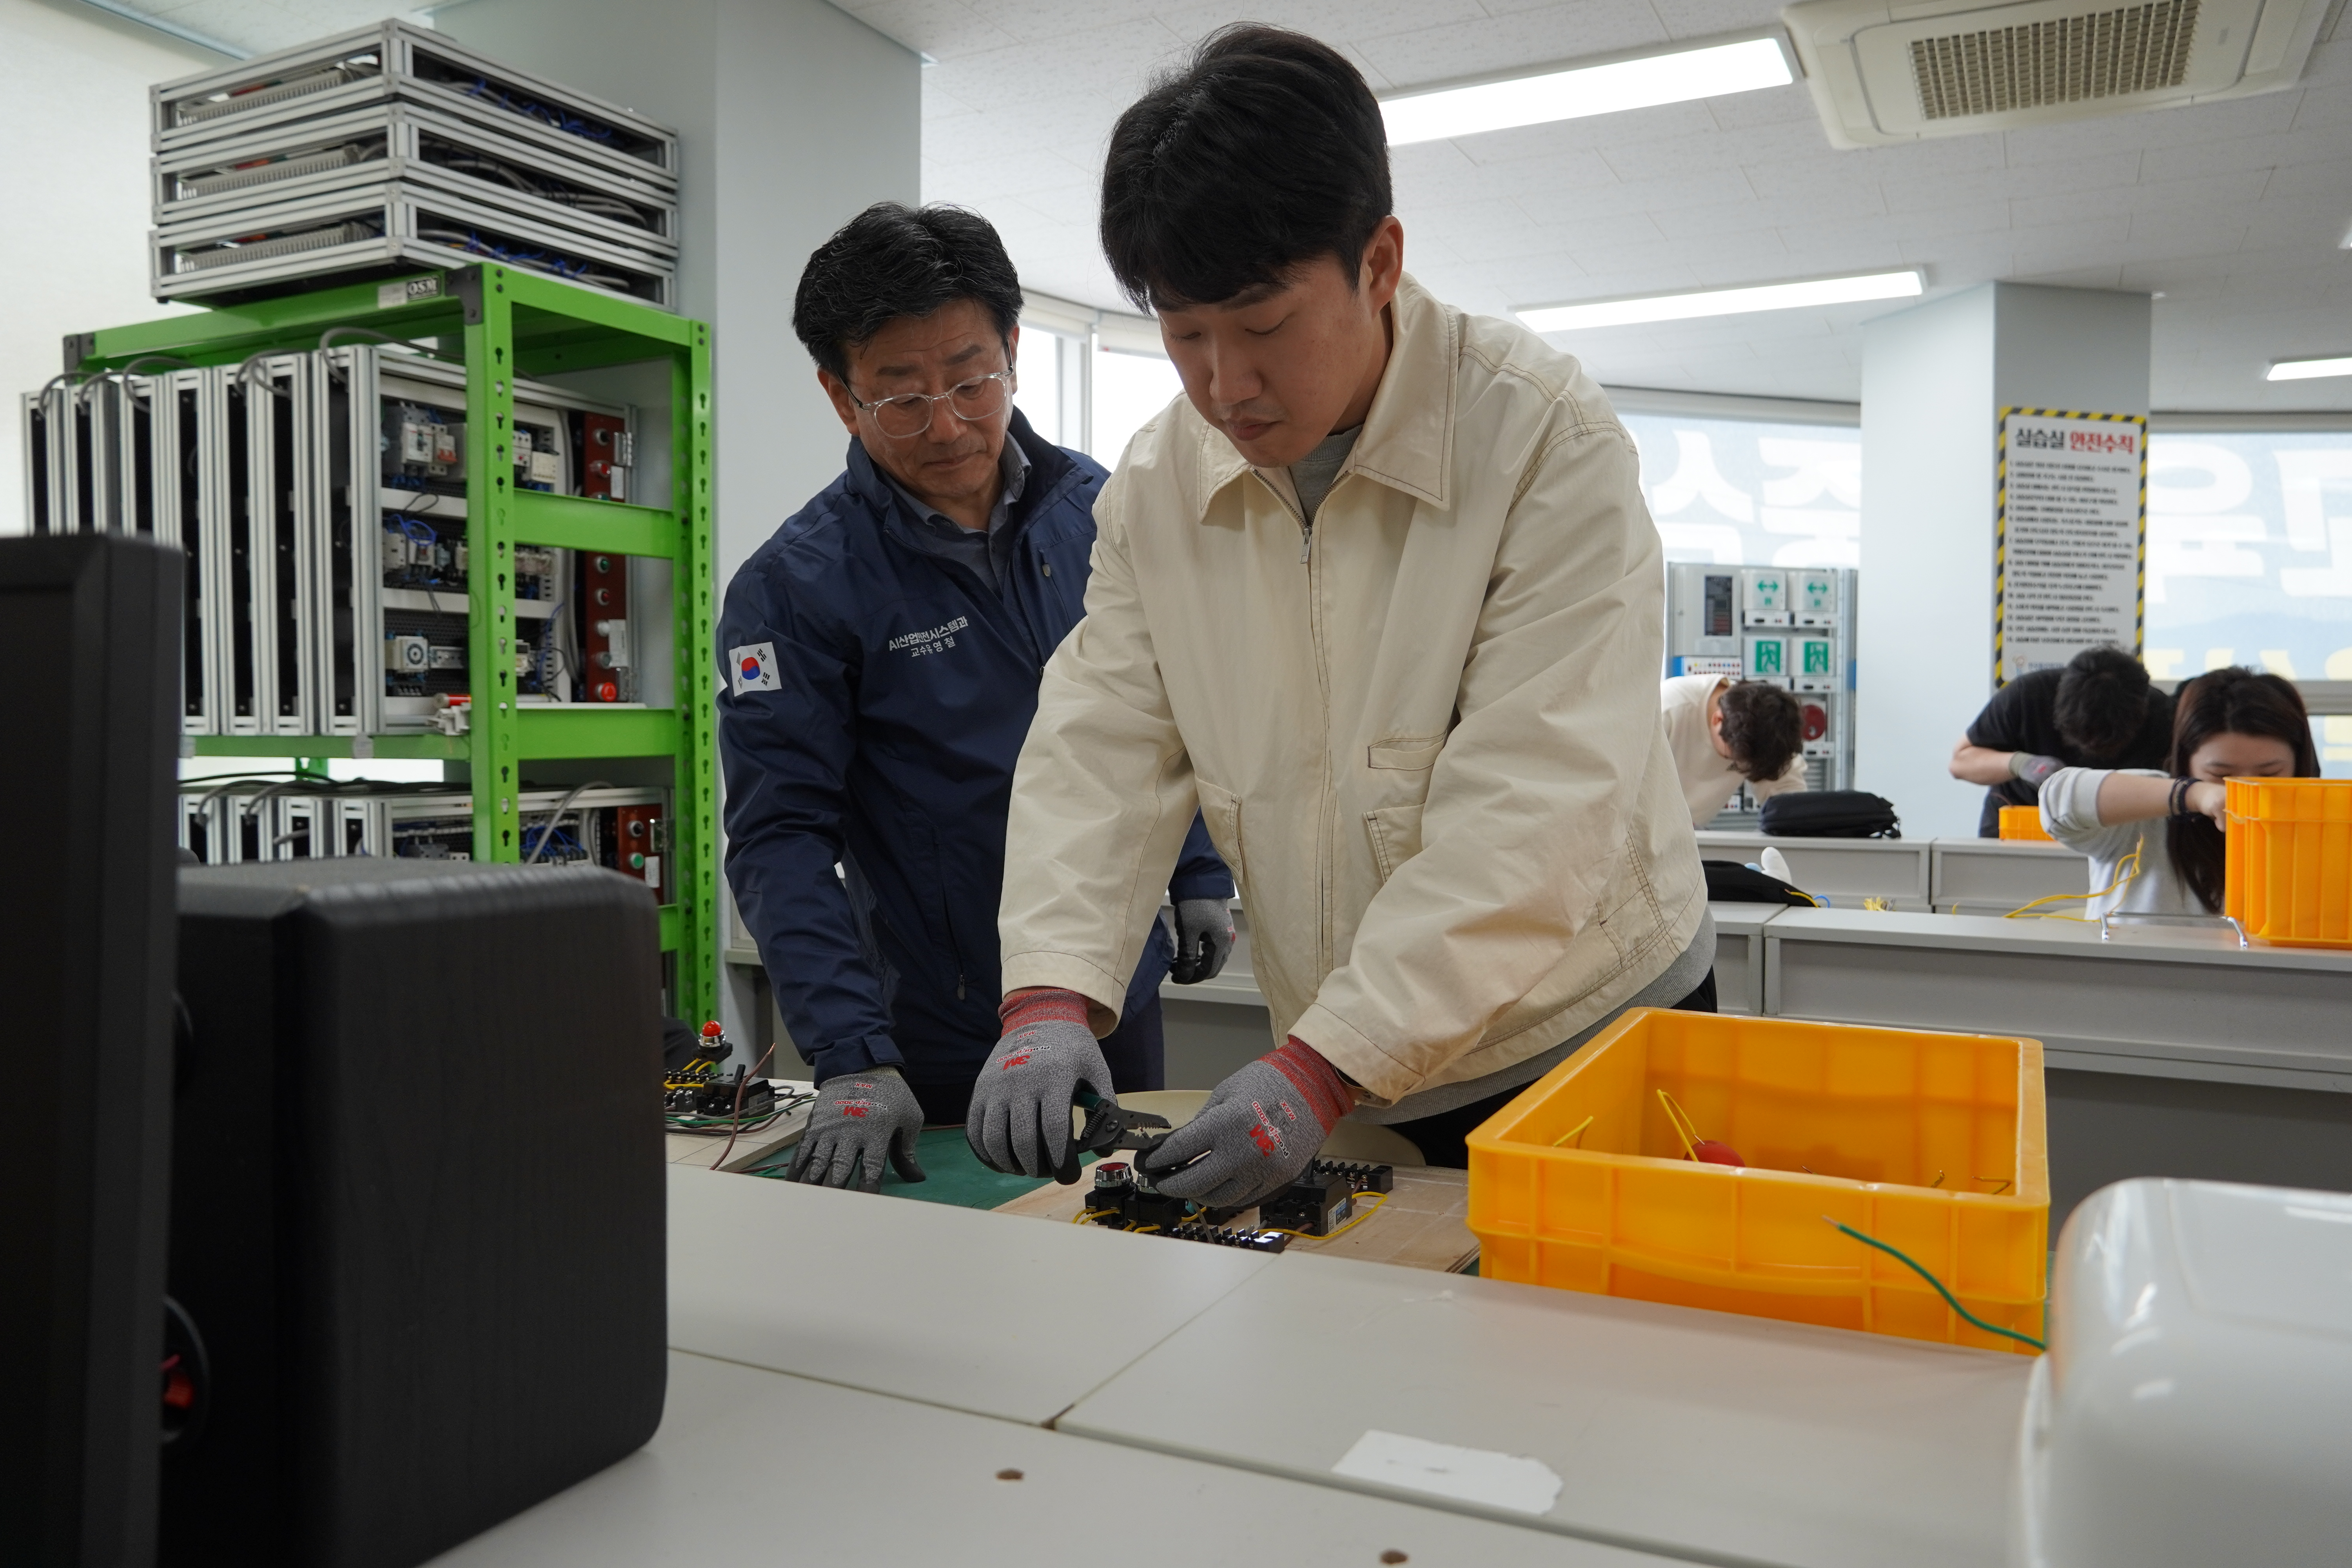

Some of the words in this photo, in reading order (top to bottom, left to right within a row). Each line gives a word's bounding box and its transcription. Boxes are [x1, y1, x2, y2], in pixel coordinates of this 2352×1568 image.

[2015, 427, 2064, 450] 실습실
[2070, 430, 2134, 455] 안전수칙
[889, 616, 968, 651] AI산업안전시스템과
[1017, 1030, 1036, 1040] MAX
[996, 1053, 1015, 1063] 3000
[1016, 1045, 1051, 1056] ProGrip
[1003, 1055, 1031, 1070] 3M
[843, 1106, 869, 1117] 3M
[1252, 1101, 1269, 1126] 3000
[1280, 1100, 1296, 1121] MAX
[1249, 1124, 1275, 1156] 3M
[1268, 1125, 1290, 1158] ProGrip
